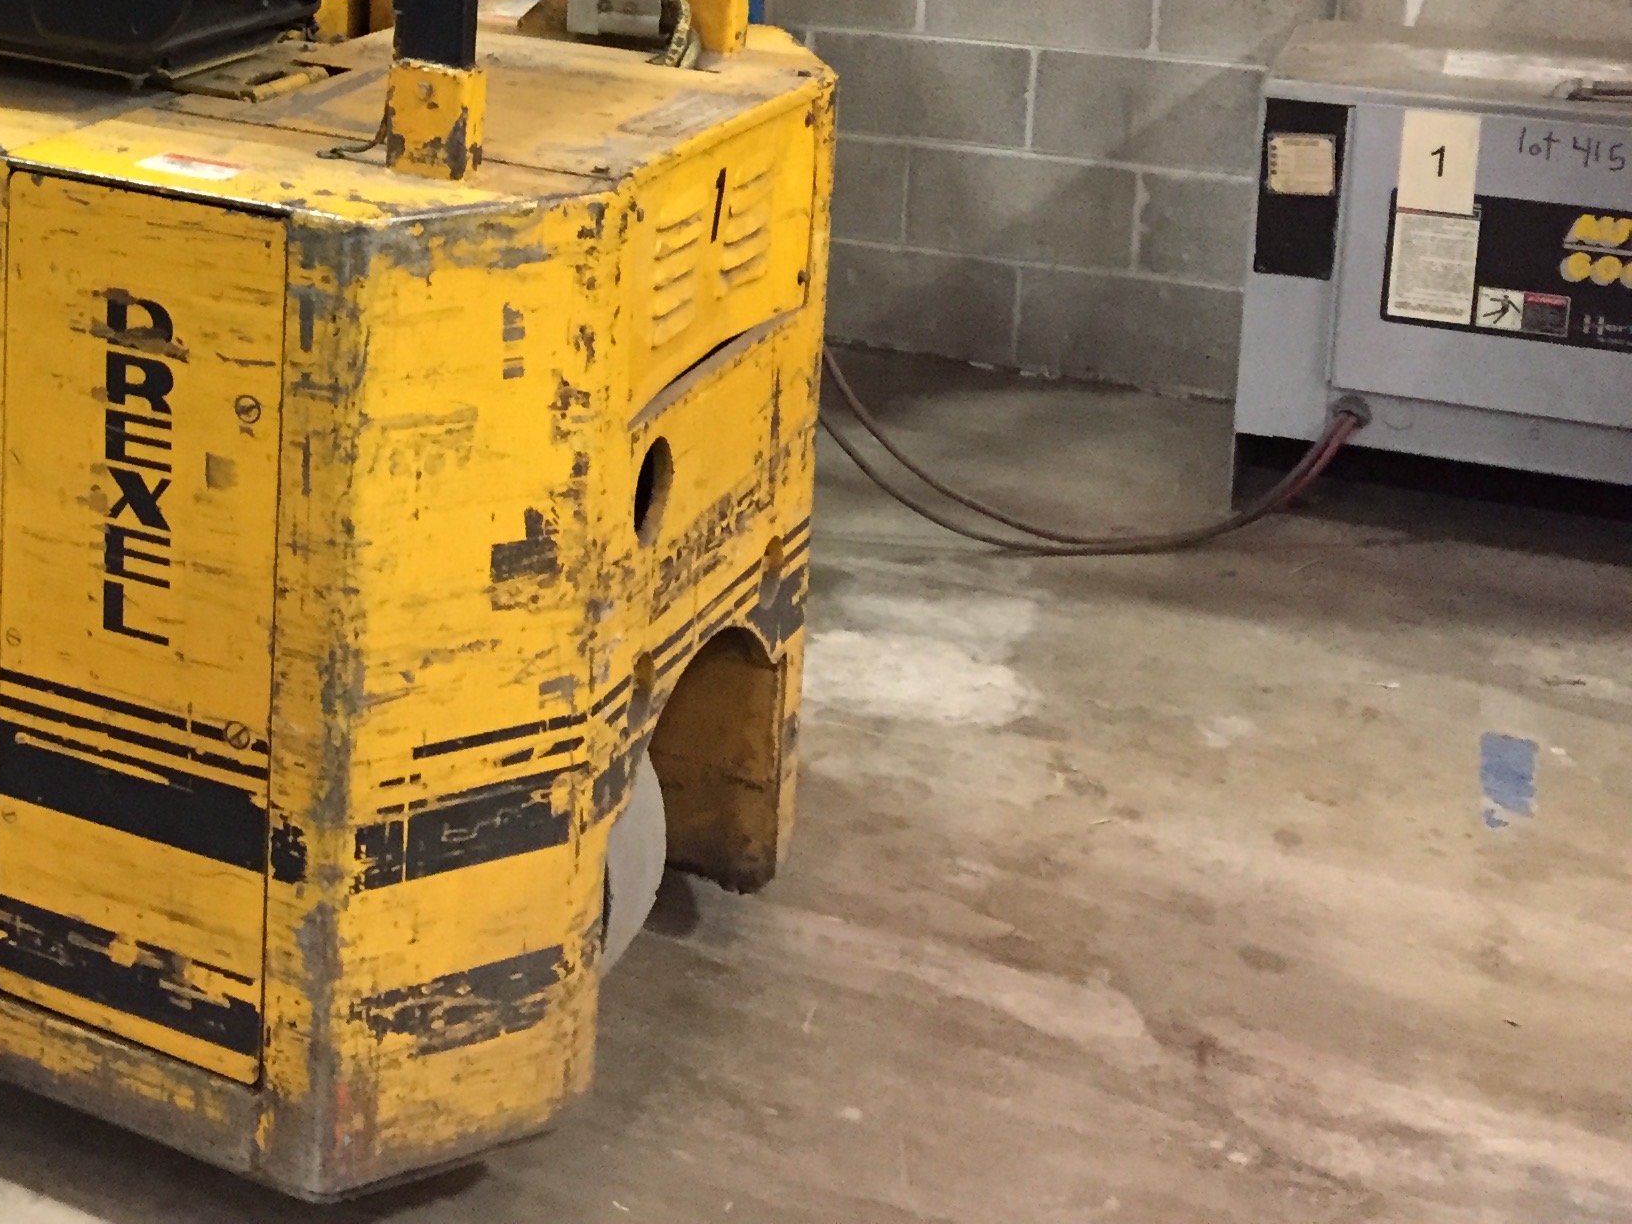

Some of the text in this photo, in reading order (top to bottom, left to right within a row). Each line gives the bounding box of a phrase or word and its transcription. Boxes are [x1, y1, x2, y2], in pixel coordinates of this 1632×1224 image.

[1431, 145, 1446, 177] 1
[1518, 127, 1626, 172] lot 415
[710, 168, 726, 243] 1
[102, 289, 174, 647] DREXEL
